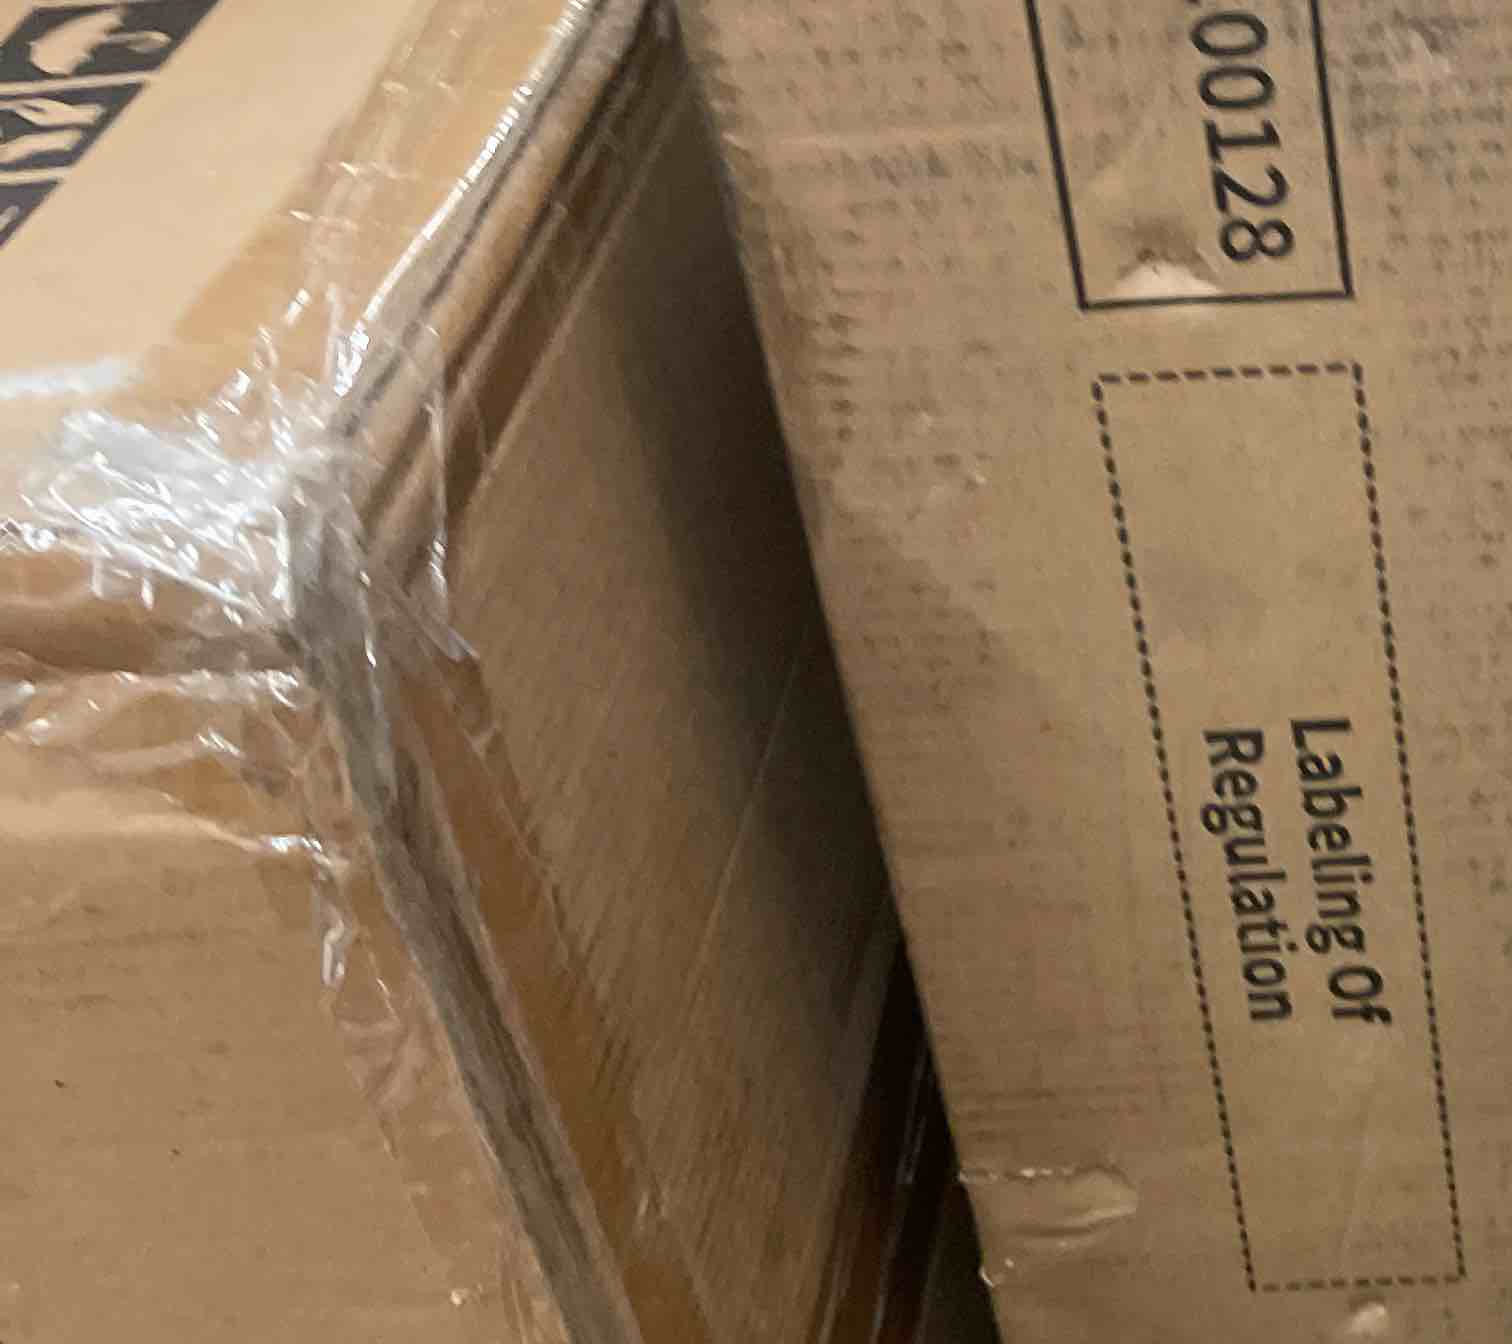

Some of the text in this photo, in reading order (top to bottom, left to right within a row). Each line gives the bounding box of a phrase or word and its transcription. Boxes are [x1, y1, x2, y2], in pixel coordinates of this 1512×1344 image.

[1201, 728, 1301, 1023] Regulation
[1290, 716, 1393, 1026] Labeling Of
